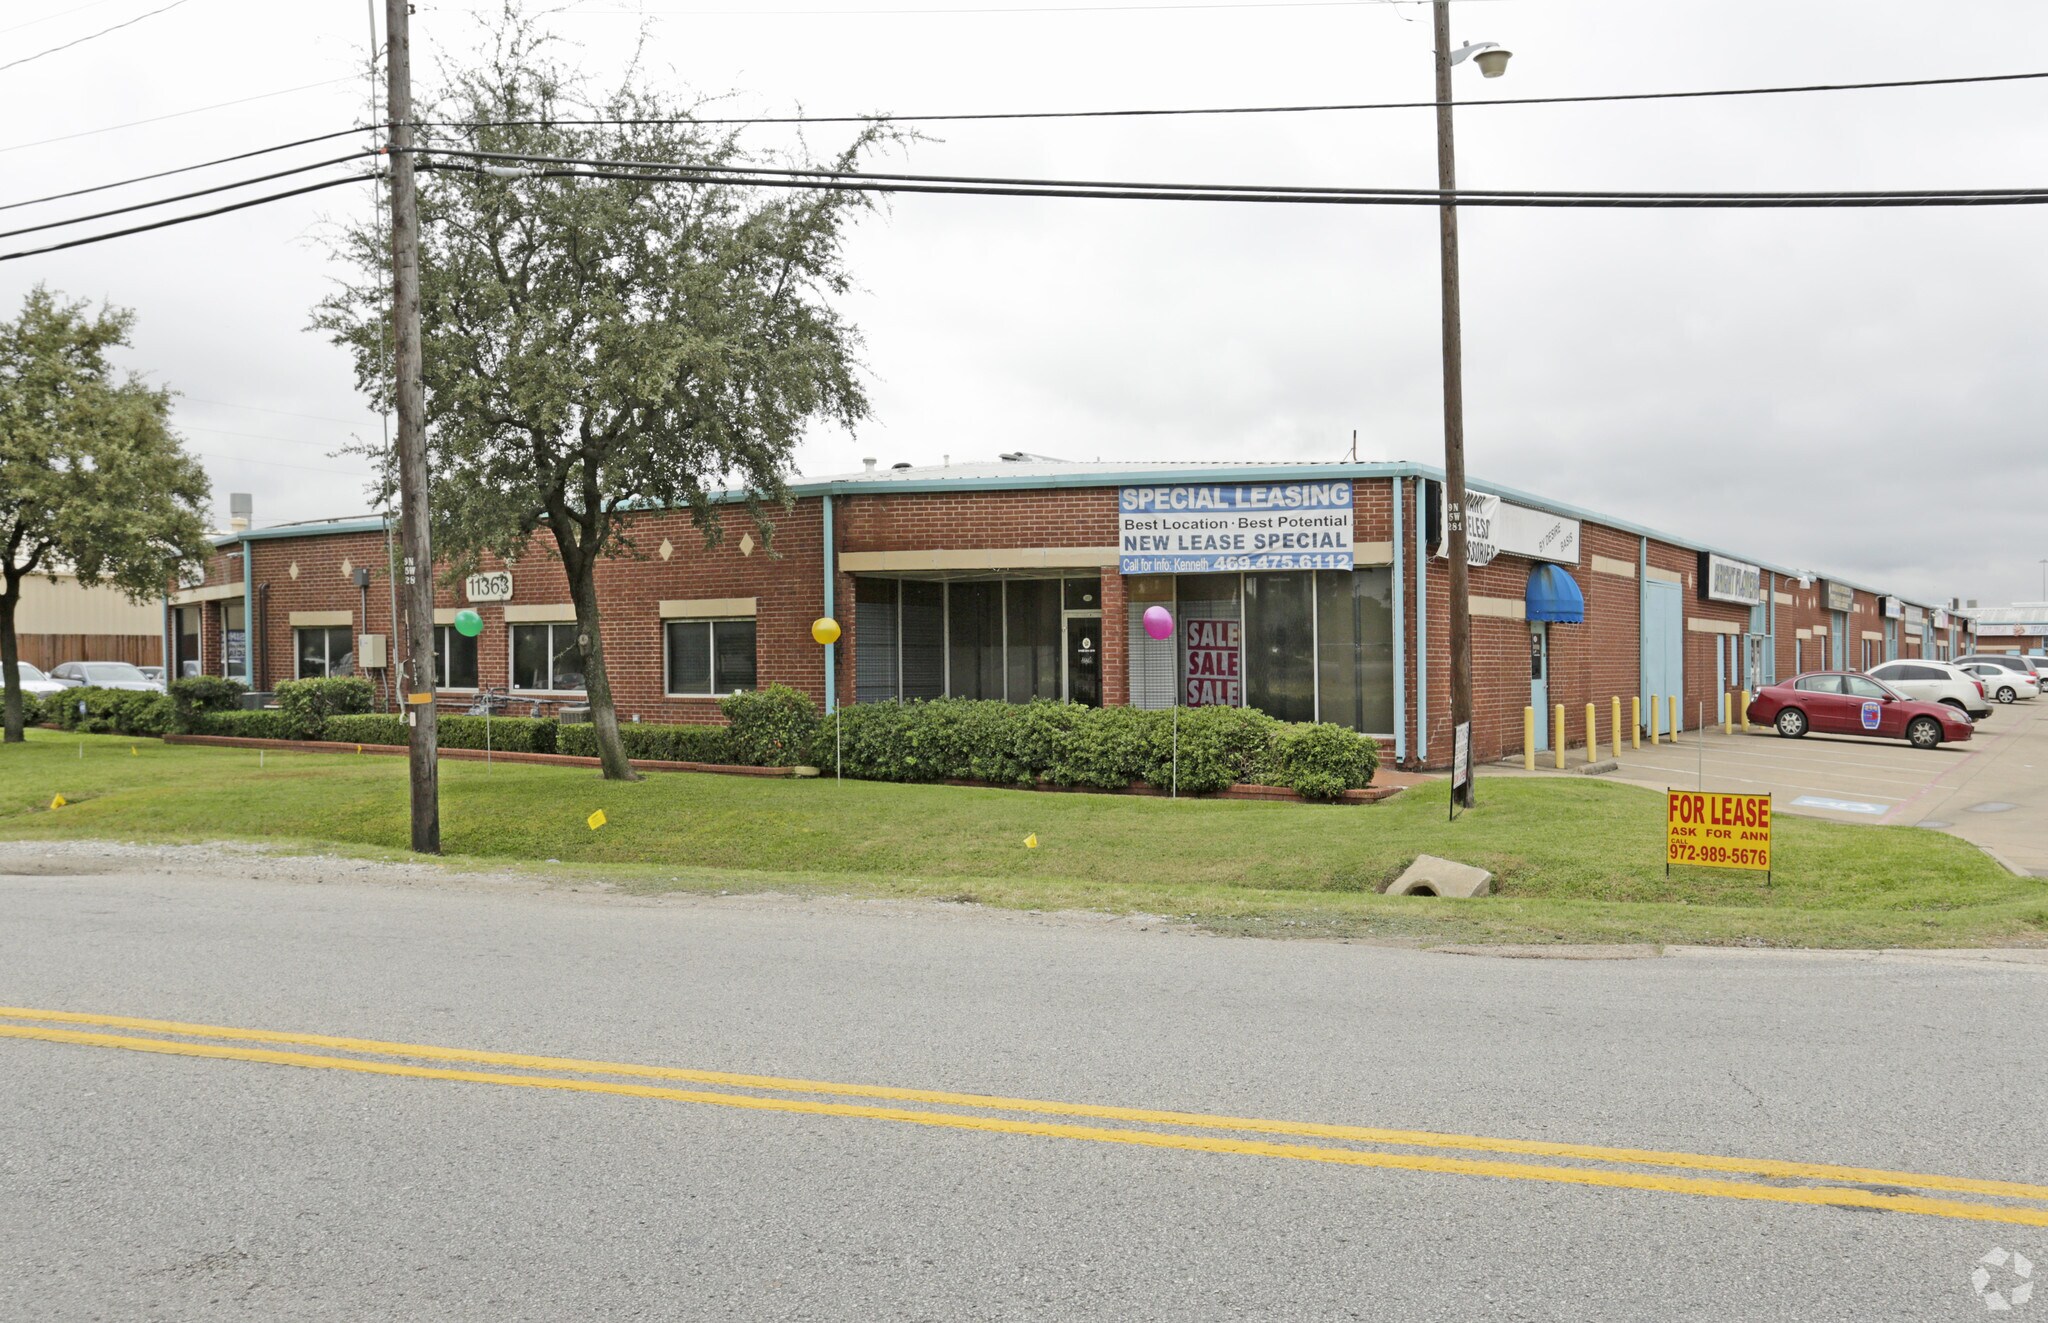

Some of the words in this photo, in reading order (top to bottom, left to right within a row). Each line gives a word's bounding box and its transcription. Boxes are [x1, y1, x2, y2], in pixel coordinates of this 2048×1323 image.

[1122, 487, 1229, 511] SPECIAL
[1235, 482, 1350, 508] LEASING
[1124, 519, 1159, 531] Best
[1162, 518, 1229, 530] Location
[1238, 517, 1273, 529] Best
[1278, 514, 1348, 528] Potential
[1124, 534, 1170, 552] NEW
[1178, 534, 1246, 551] LEASE
[1253, 531, 1348, 550] SPECIAL
[1123, 559, 1139, 572] Call
[1141, 558, 1153, 572] for
[1154, 558, 1172, 572] Info:
[1174, 557, 1209, 571] Kenneth
[1212, 554, 1350, 571] 469.475.6112
[468, 575, 509, 596] 11363
[1188, 622, 1239, 647] SALE
[1189, 651, 1238, 676] SALE
[1188, 680, 1238, 705] SALE
[1669, 794, 1705, 824] FOR
[1710, 796, 1769, 828] LEASE
[1671, 827, 1697, 837] ASK
[1706, 829, 1732, 839] FOR
[1740, 831, 1768, 841] ANN
[1670, 844, 1767, 866] 972-989-5676
